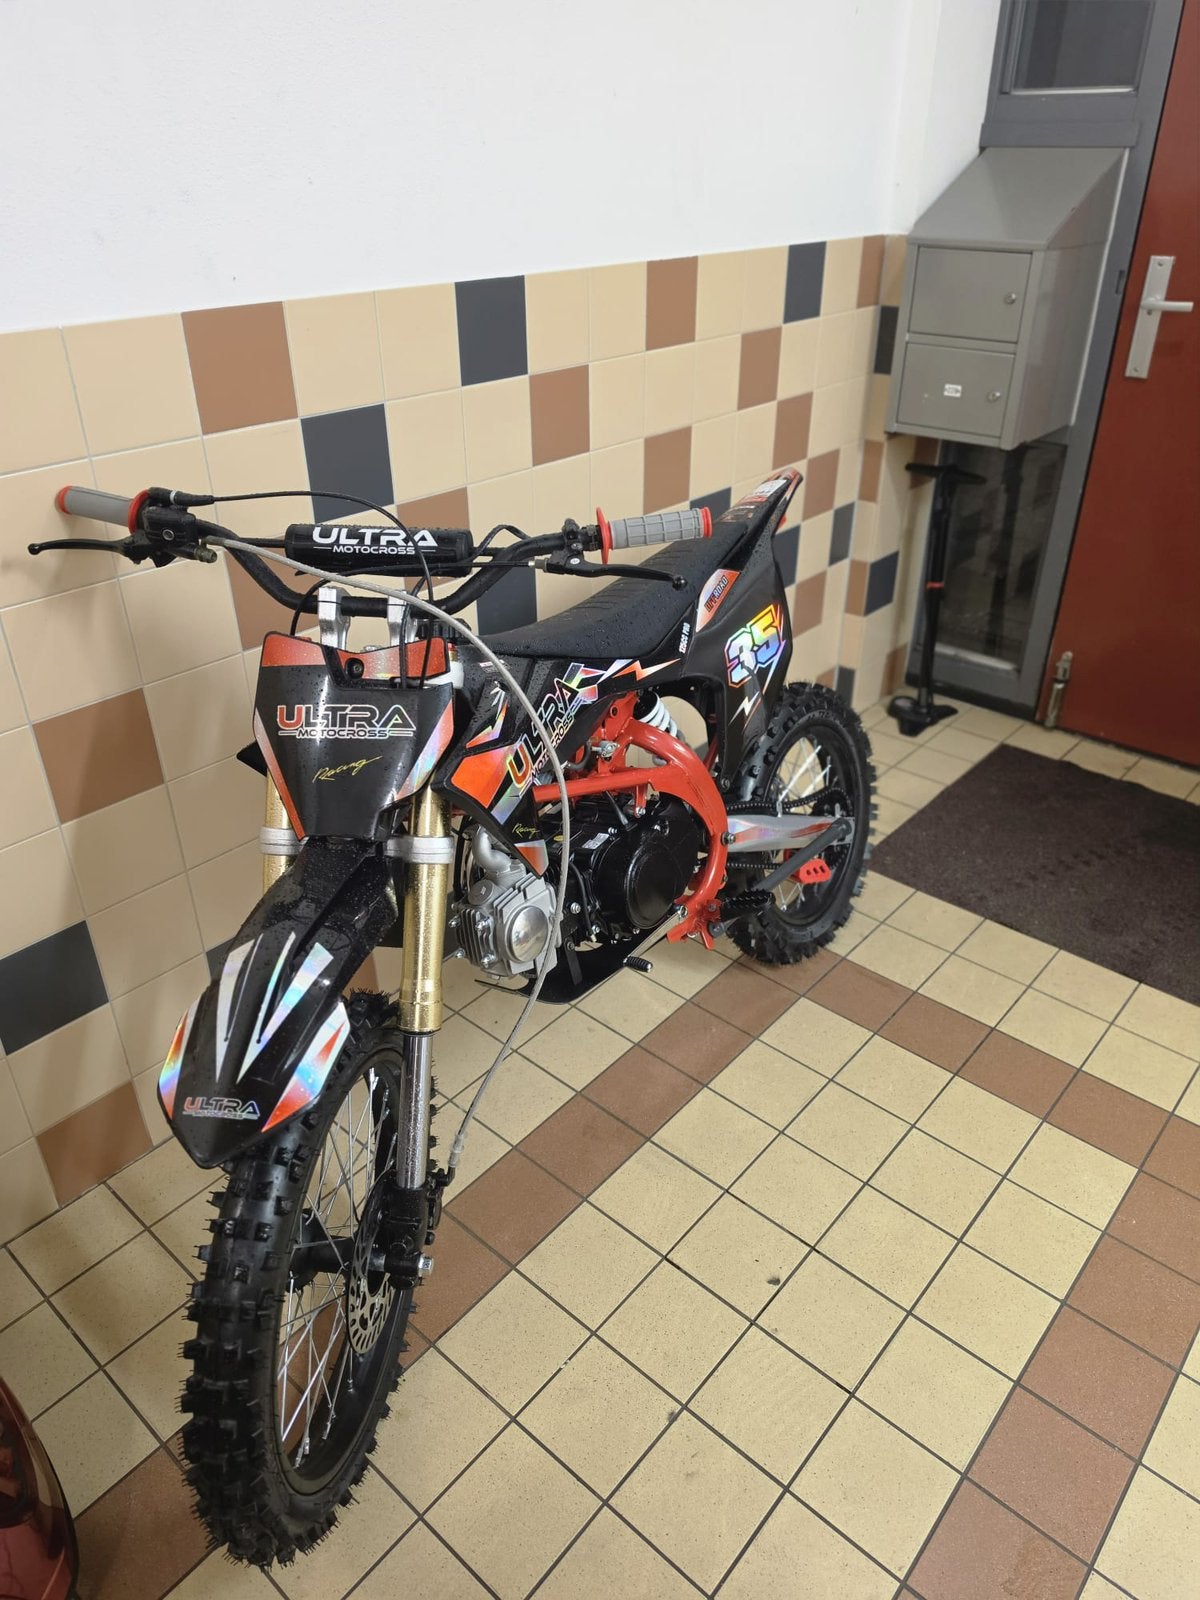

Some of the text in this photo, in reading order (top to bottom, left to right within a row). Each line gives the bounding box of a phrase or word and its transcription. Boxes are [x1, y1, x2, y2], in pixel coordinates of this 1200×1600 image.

[312, 526, 438, 547] ULTRA
[332, 545, 416, 555] MOTOCROSS
[725, 604, 782, 688] 35
[277, 704, 417, 731] ULTRA
[296, 728, 389, 739] MOTOCROSS
[312, 755, 383, 784] Racing
[512, 822, 540, 839] Racing
[184, 1097, 261, 1117] ULTRA
